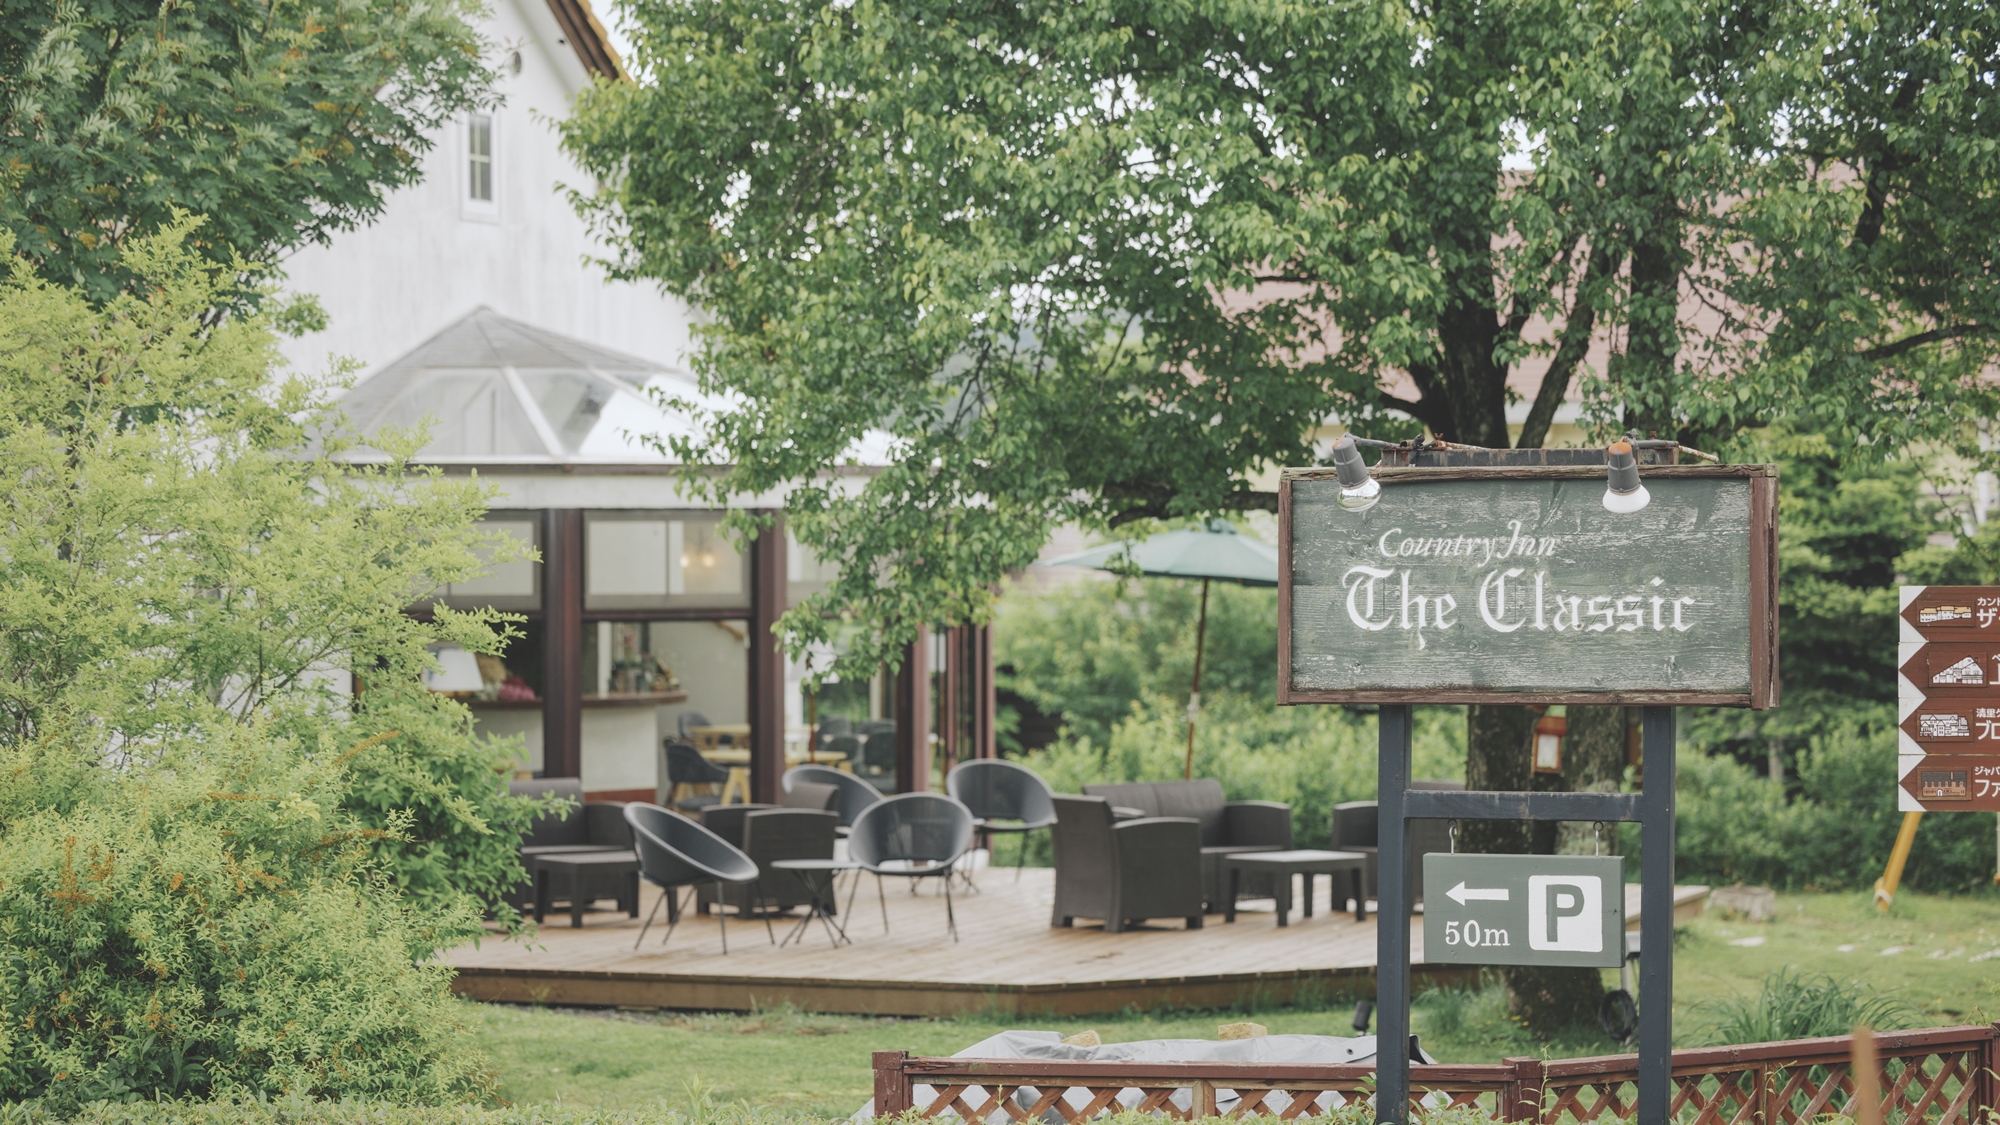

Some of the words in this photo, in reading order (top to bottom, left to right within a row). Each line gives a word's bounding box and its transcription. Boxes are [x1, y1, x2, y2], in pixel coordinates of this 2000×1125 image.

[1379, 528, 1495, 567] Country
[1497, 520, 1556, 559] Inn
[1343, 566, 1457, 650] The
[1479, 568, 1696, 633] Classic
[1445, 919, 1510, 947] 50m
[1545, 884, 1585, 942] P
